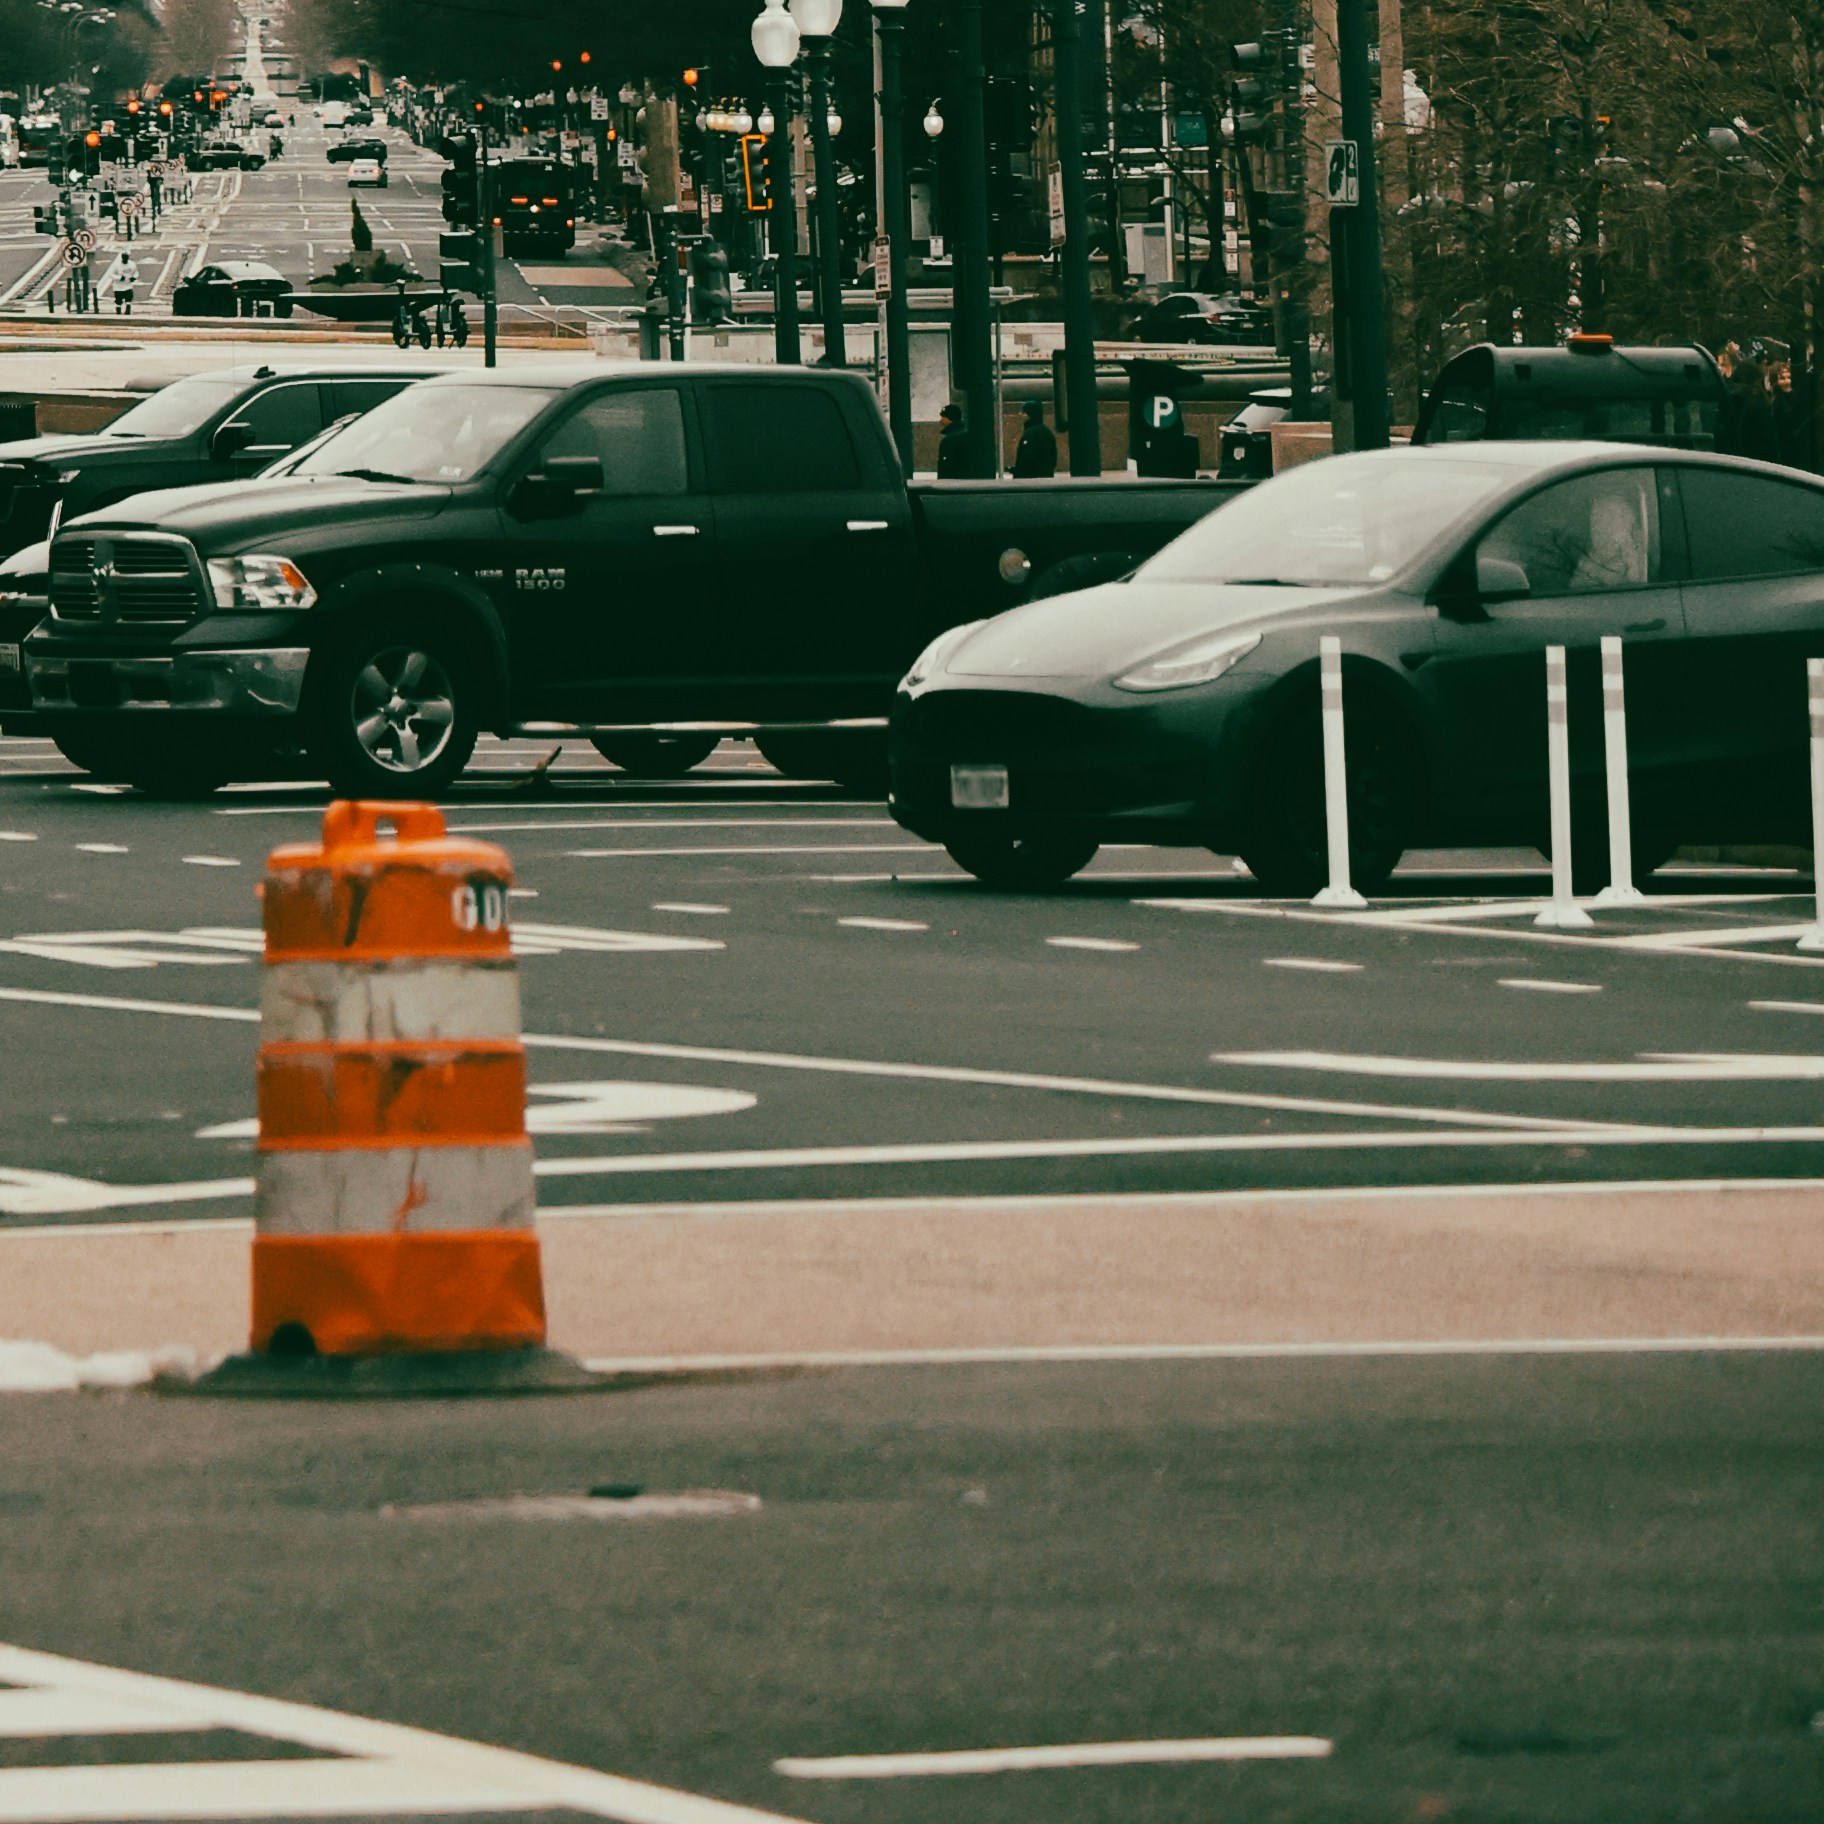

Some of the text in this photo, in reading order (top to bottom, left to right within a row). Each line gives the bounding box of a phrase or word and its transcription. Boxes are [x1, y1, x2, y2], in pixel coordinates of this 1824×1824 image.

[1153, 396, 1174, 428] P
[515, 568, 565, 579] RAM
[515, 579, 565, 590] 1500
